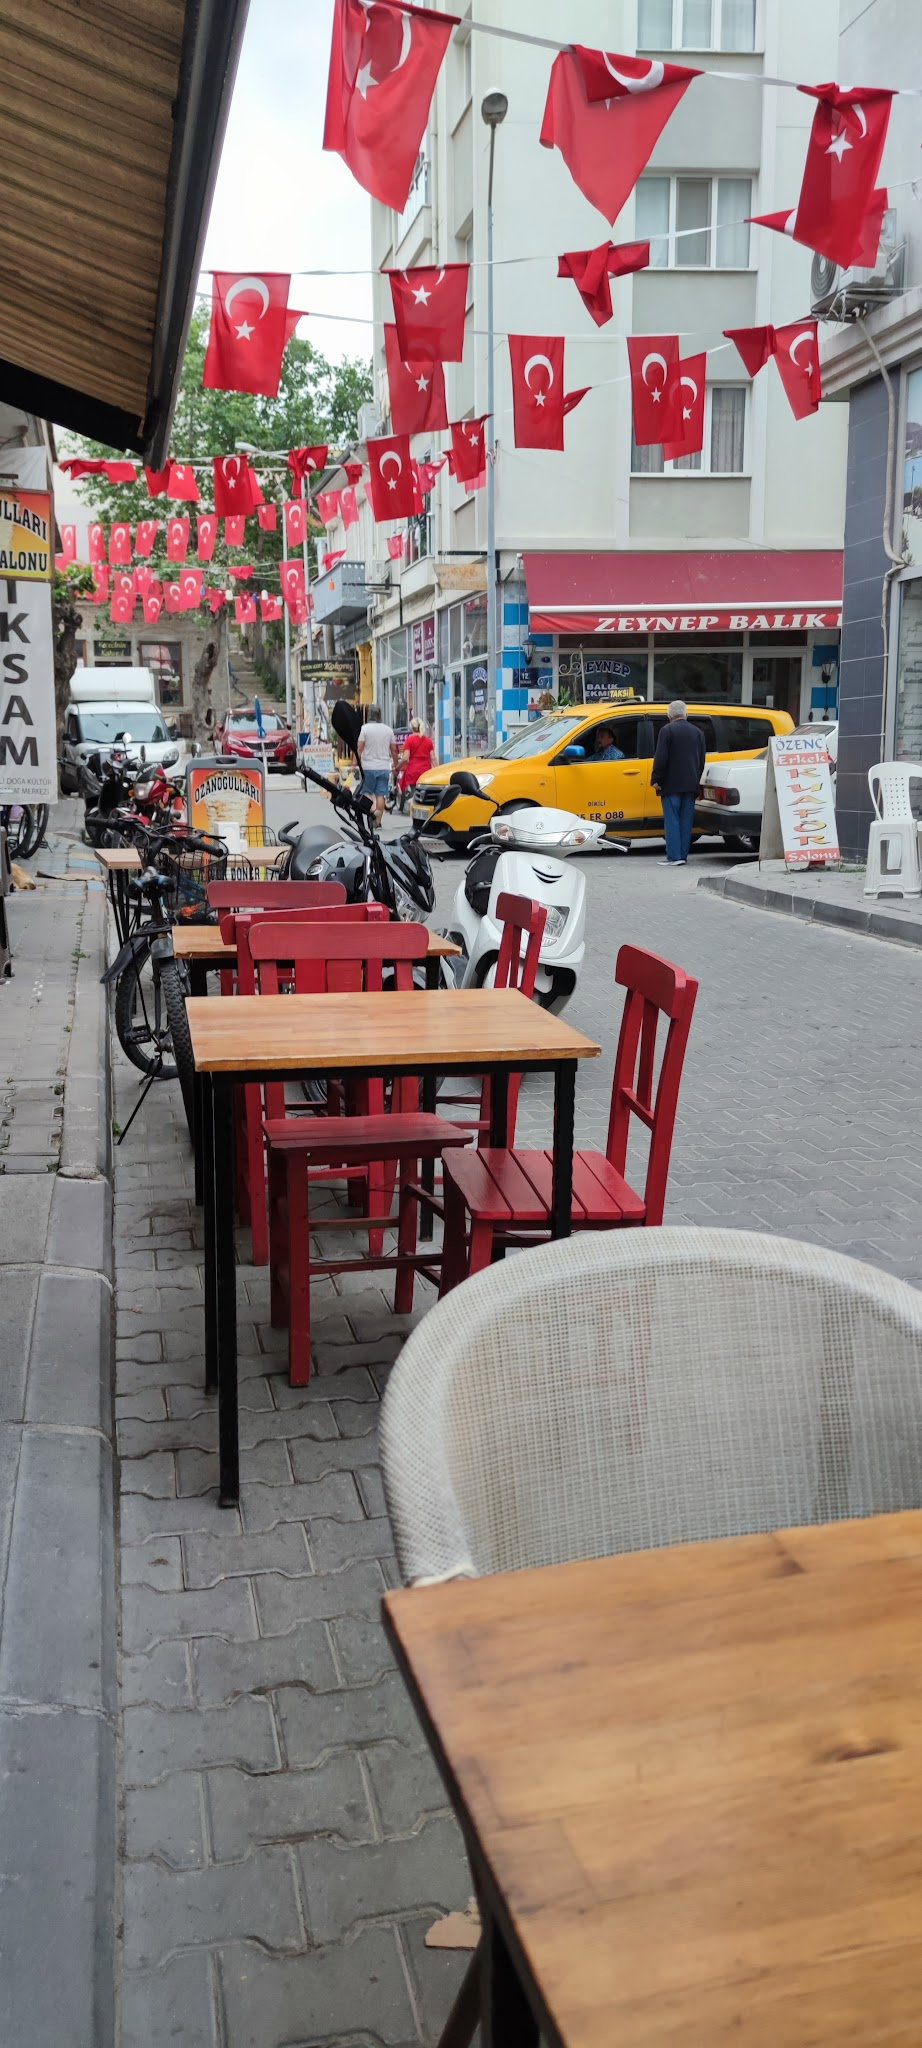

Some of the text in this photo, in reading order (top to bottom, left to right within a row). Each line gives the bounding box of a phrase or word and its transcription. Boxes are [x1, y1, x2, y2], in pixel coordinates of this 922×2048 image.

[593, 616, 719, 632] ZEYNEP
[729, 614, 828, 630] BALIK
[778, 752, 827, 766] Erkek
[589, 812, 602, 821] ER
[604, 810, 624, 820] 088
[788, 850, 838, 862] Salonu
